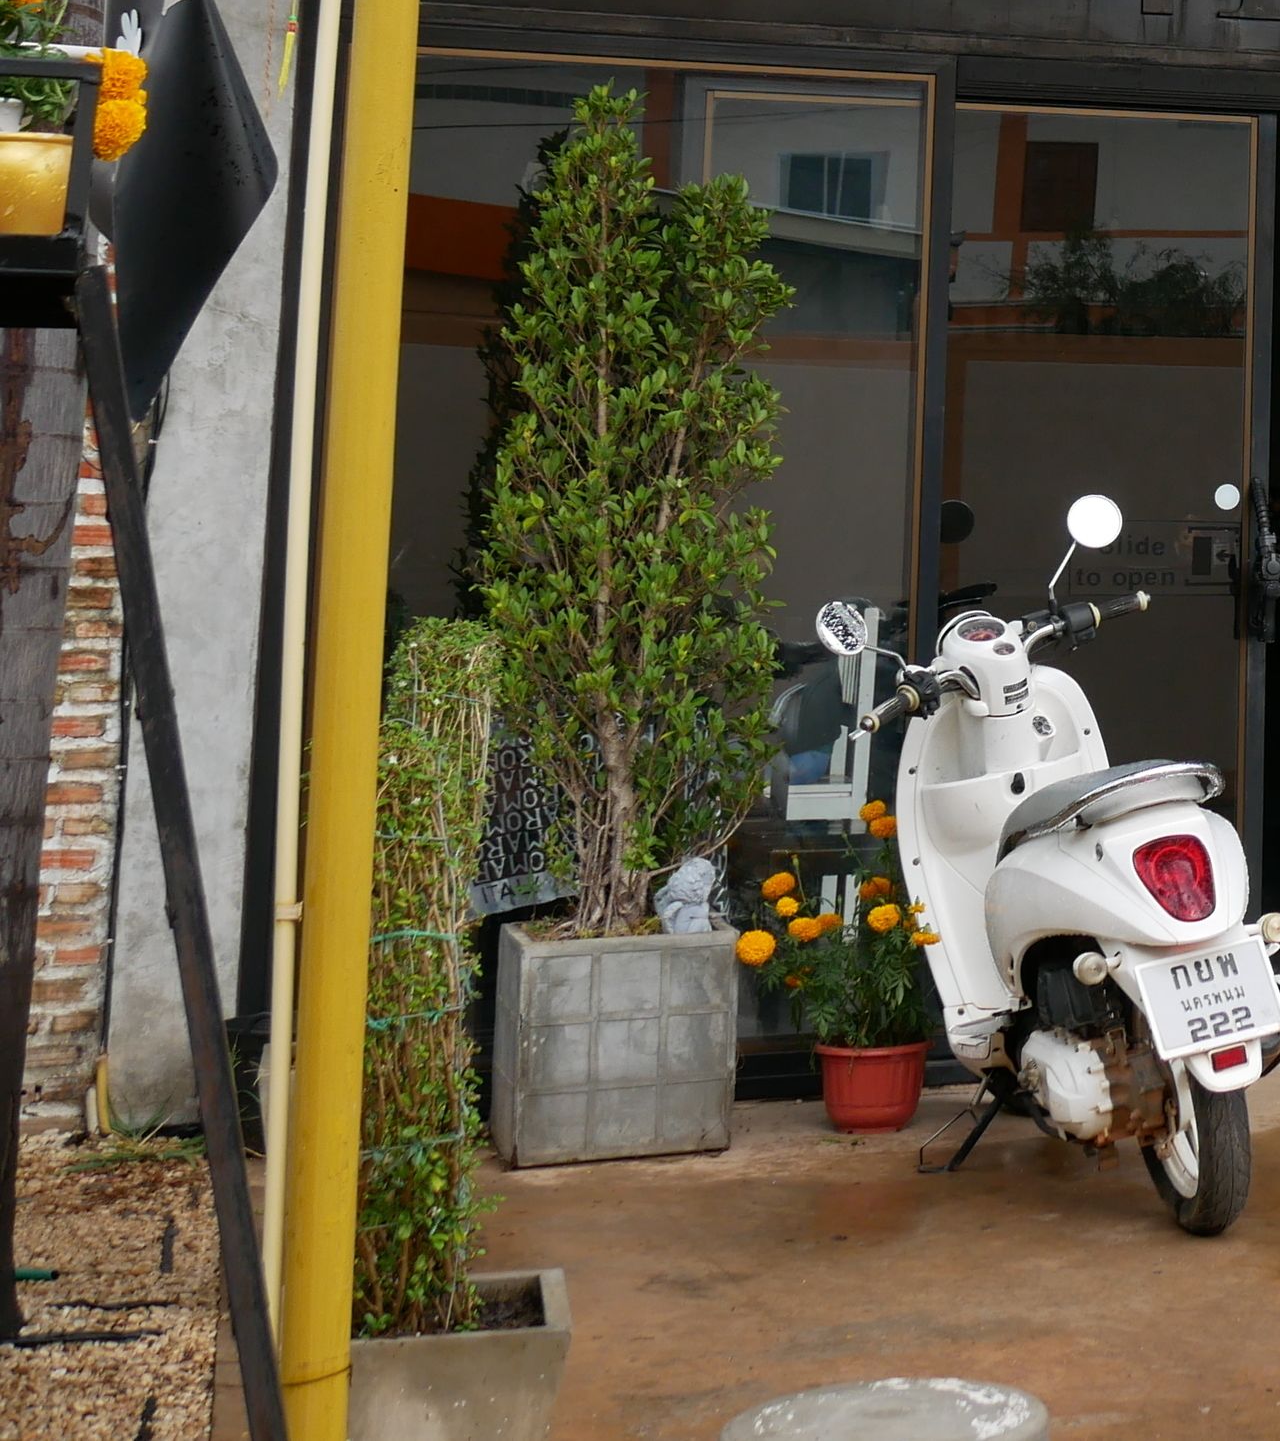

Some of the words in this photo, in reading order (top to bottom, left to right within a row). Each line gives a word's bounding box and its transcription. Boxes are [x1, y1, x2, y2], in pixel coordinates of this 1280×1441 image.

[1076, 568, 1101, 586] to
[1113, 570, 1175, 590] open
[1180, 985, 1246, 1012] นครพนม
[1187, 1005, 1255, 1044] 222
